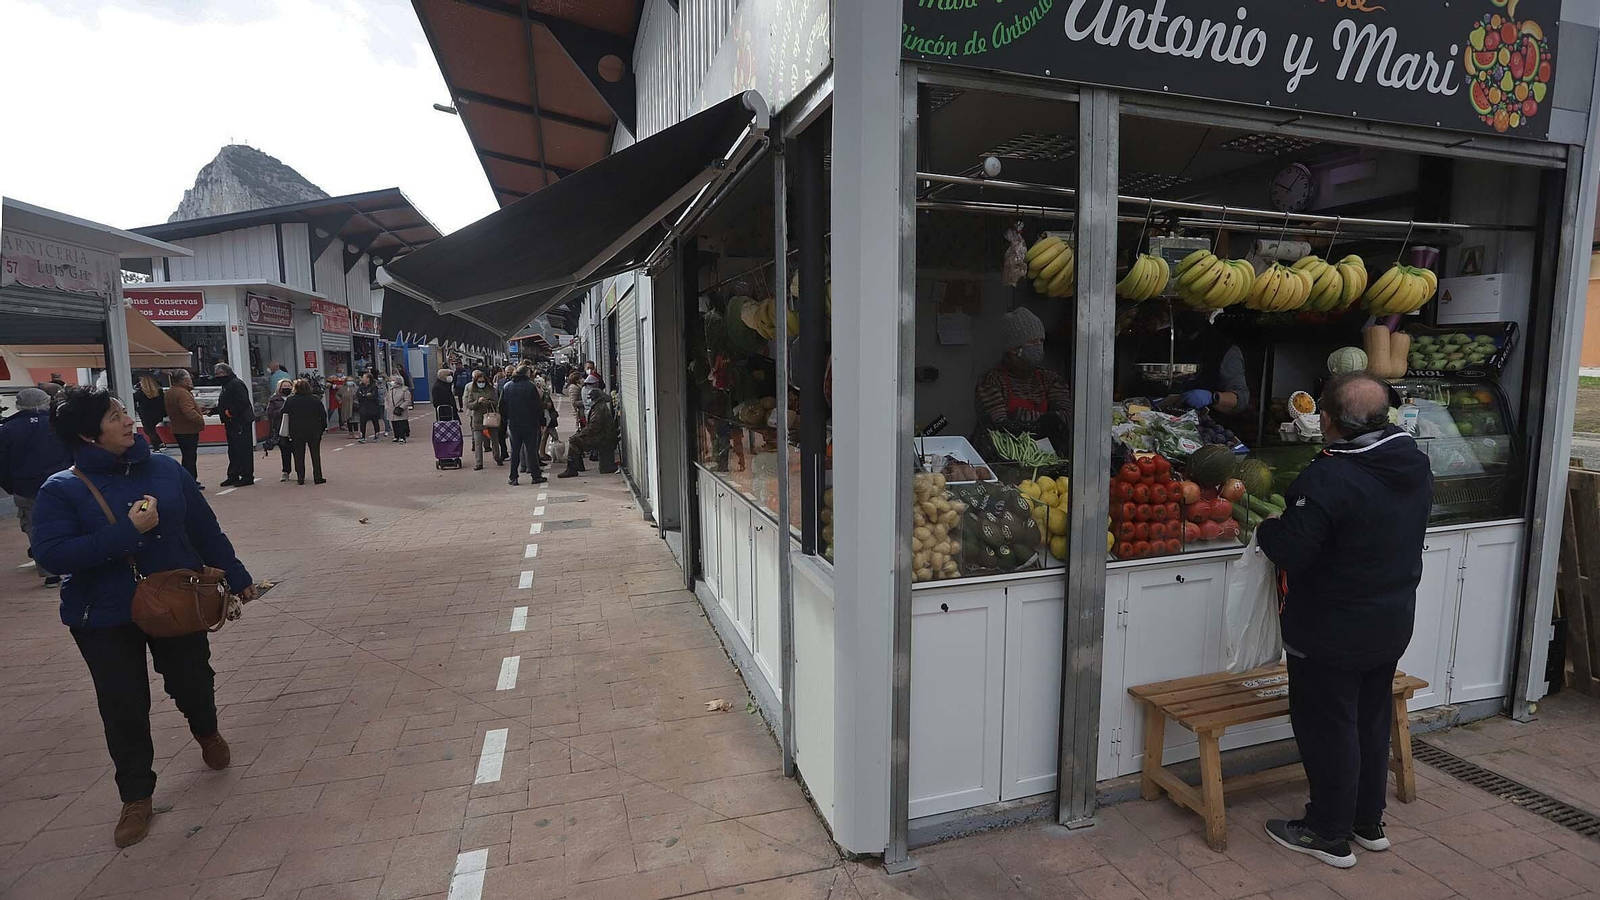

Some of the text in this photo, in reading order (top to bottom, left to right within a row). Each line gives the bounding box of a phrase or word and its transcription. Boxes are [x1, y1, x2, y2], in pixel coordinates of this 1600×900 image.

[963, 31, 987, 55] de
[1064, 0, 1460, 96] Antonio y Mari
[6, 260, 18, 274] 57
[154, 297, 198, 305] Conservas
[158, 308, 189, 316] Aceites
[1407, 369, 1445, 377] AROL
